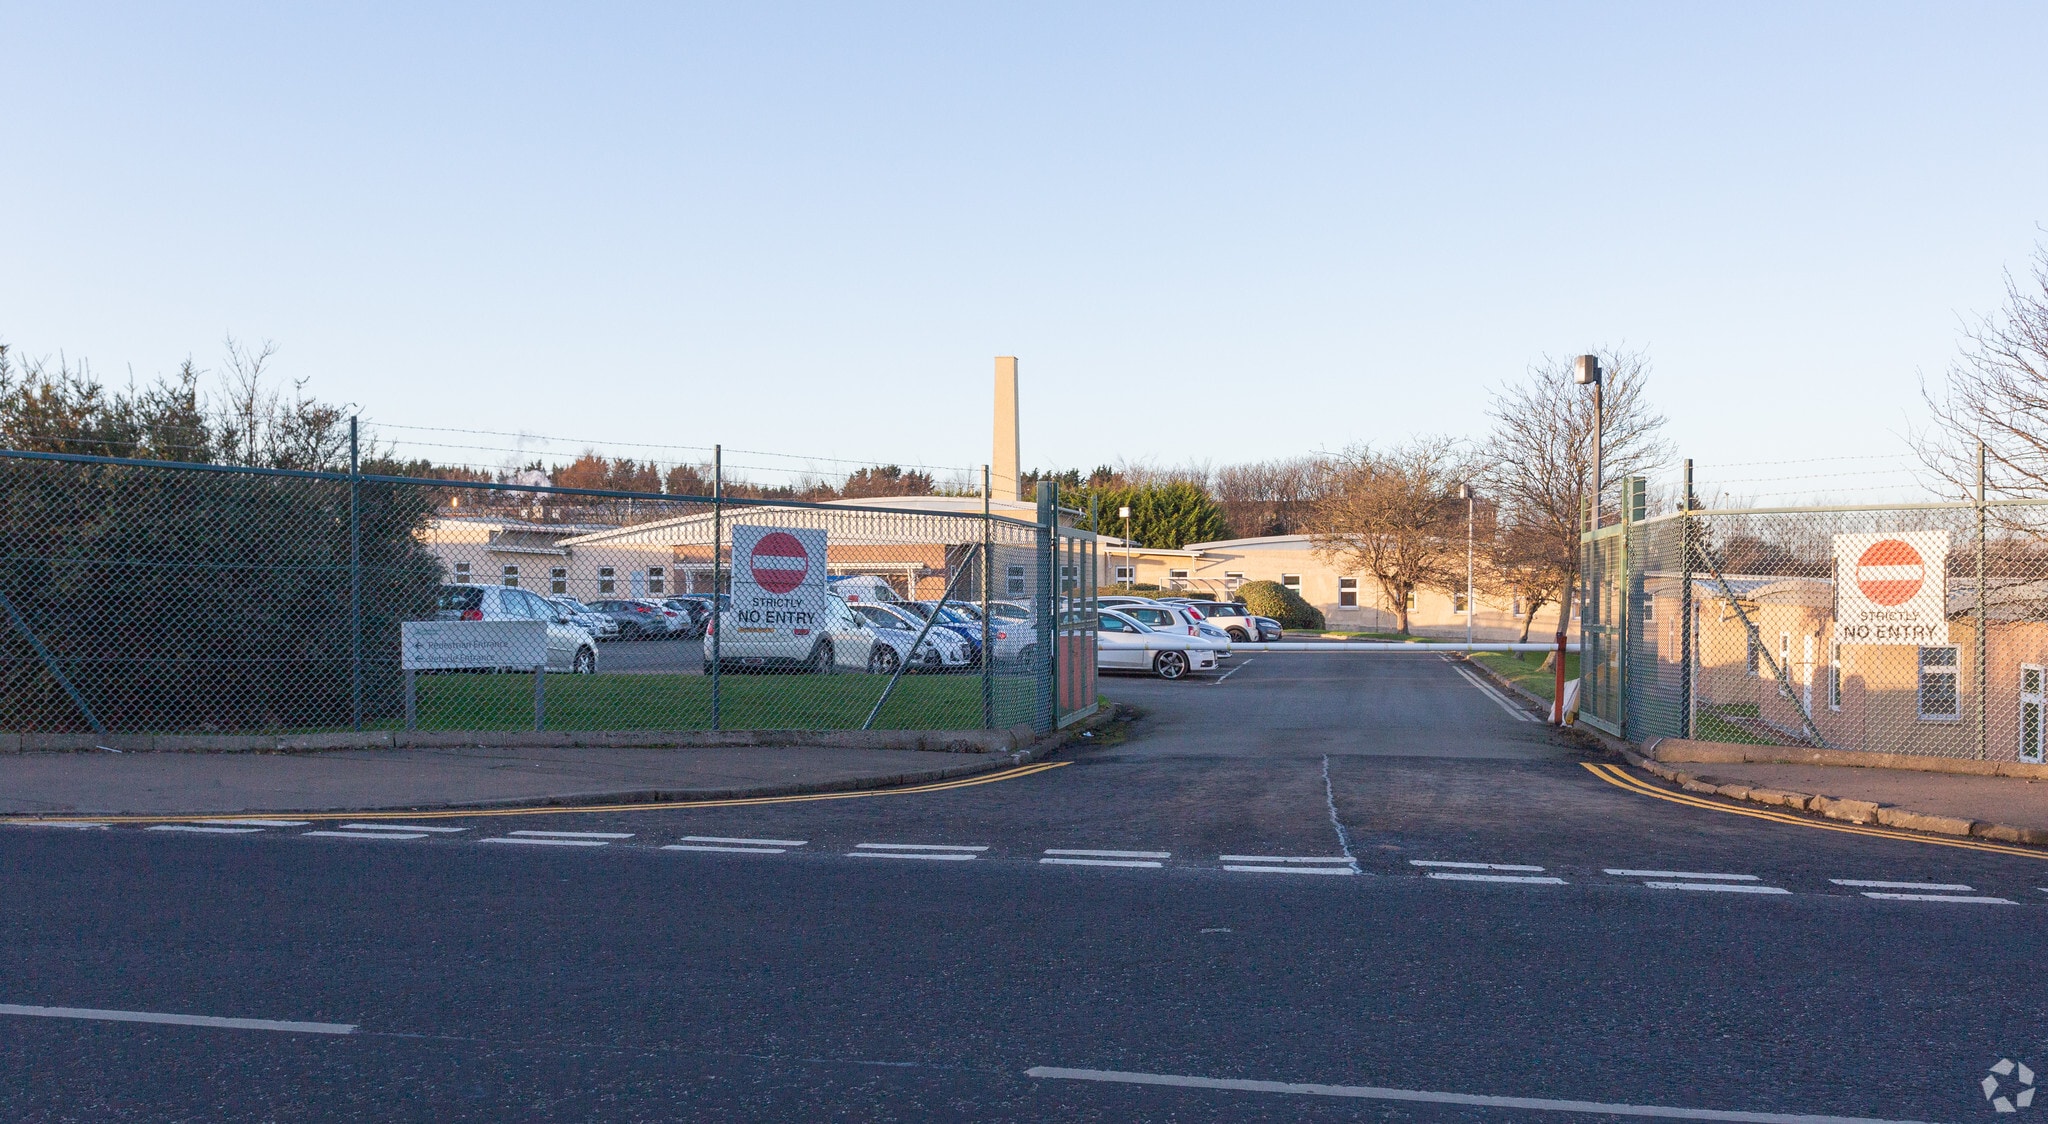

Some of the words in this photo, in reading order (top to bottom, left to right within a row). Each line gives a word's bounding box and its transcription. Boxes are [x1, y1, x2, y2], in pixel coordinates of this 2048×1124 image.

[752, 597, 802, 608] STRICTLY
[738, 610, 760, 623] NO
[766, 611, 815, 624] ENTRY
[1860, 611, 1919, 621] STRICTLY
[1844, 625, 1869, 639] NO
[1876, 624, 1937, 640] ENTRY
